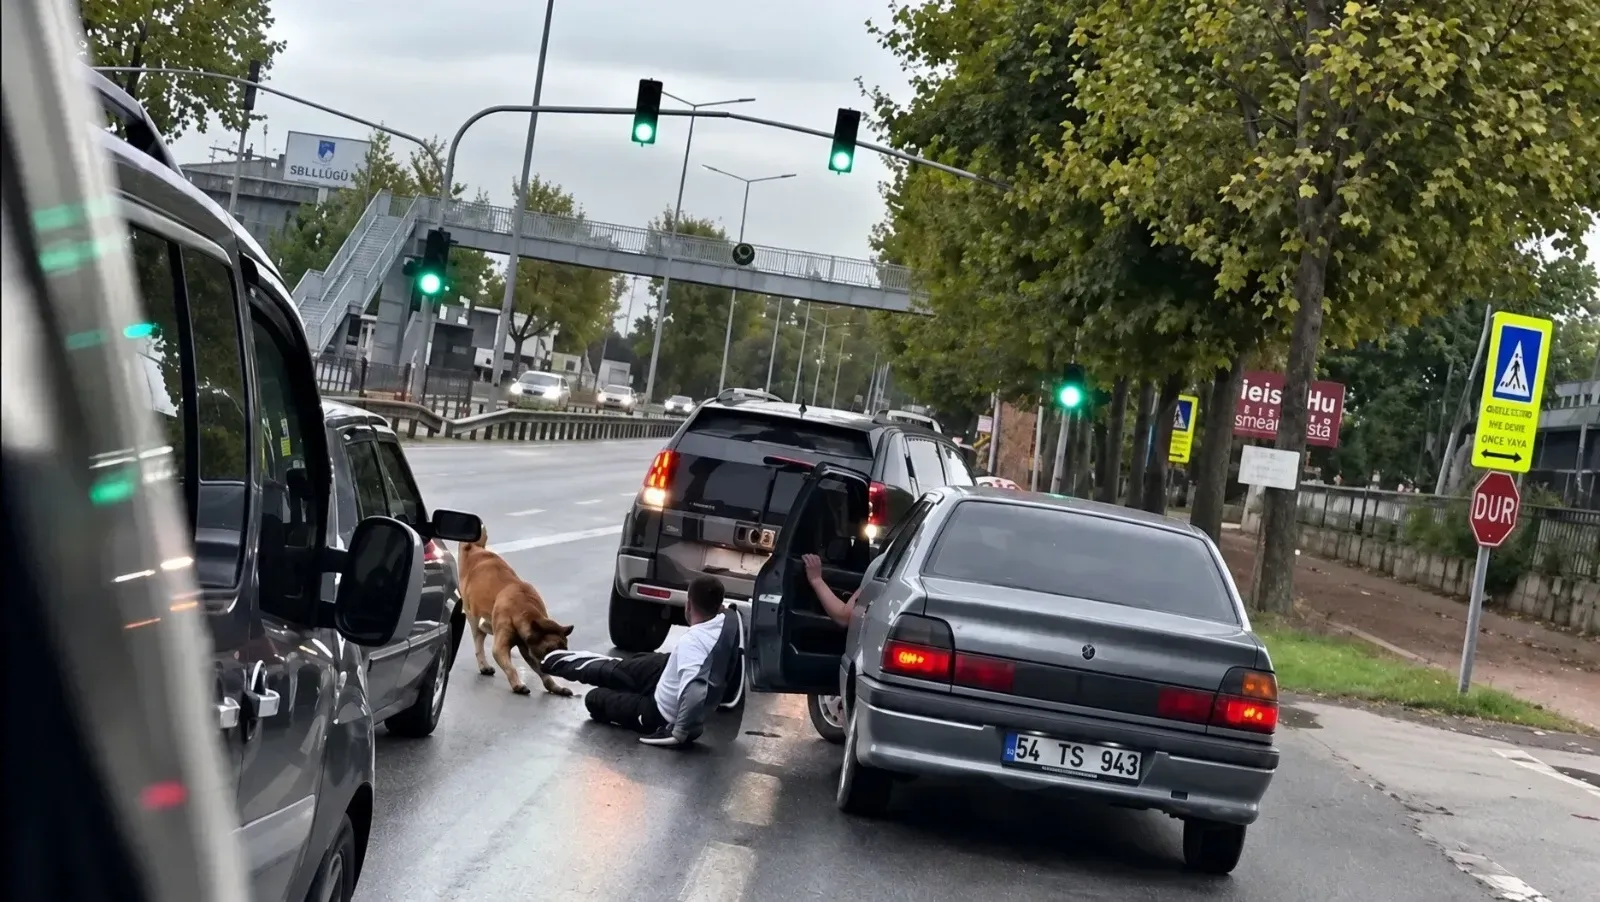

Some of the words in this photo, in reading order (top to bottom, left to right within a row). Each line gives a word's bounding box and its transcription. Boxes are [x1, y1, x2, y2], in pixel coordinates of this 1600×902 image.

[1474, 492, 1515, 525] DUR
[1016, 738, 1040, 762] 54
[1058, 743, 1084, 768] TS
[1100, 750, 1139, 776] 943
